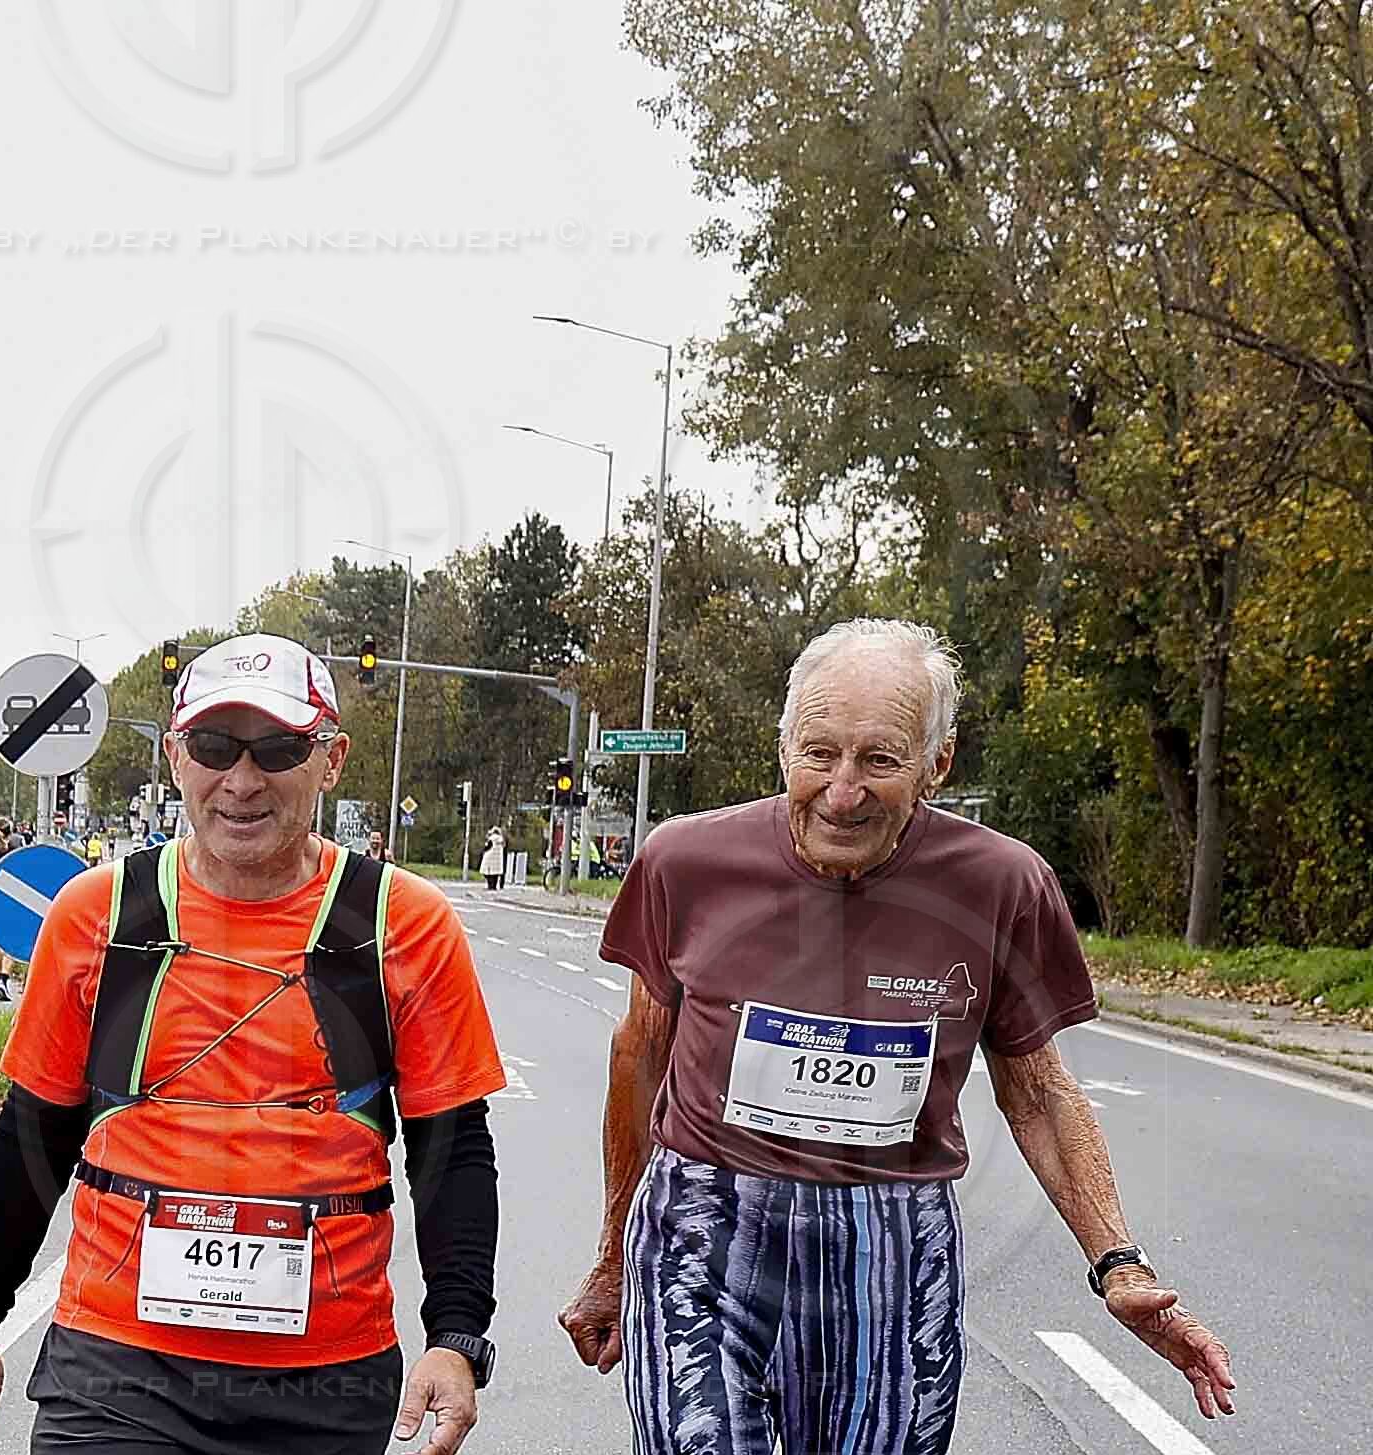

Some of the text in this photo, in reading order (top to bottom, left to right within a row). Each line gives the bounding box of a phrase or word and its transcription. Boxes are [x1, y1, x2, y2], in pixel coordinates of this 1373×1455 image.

[893, 977, 938, 992] GRAZ
[785, 1021, 818, 1035] GRAZ
[780, 1030, 848, 1048] MARATHON
[790, 1054, 877, 1089] 1820
[179, 1204, 208, 1216] GRAZ
[176, 1213, 236, 1228] MARATHON
[184, 1238, 266, 1270] 4617
[199, 1287, 243, 1302] Gerald
